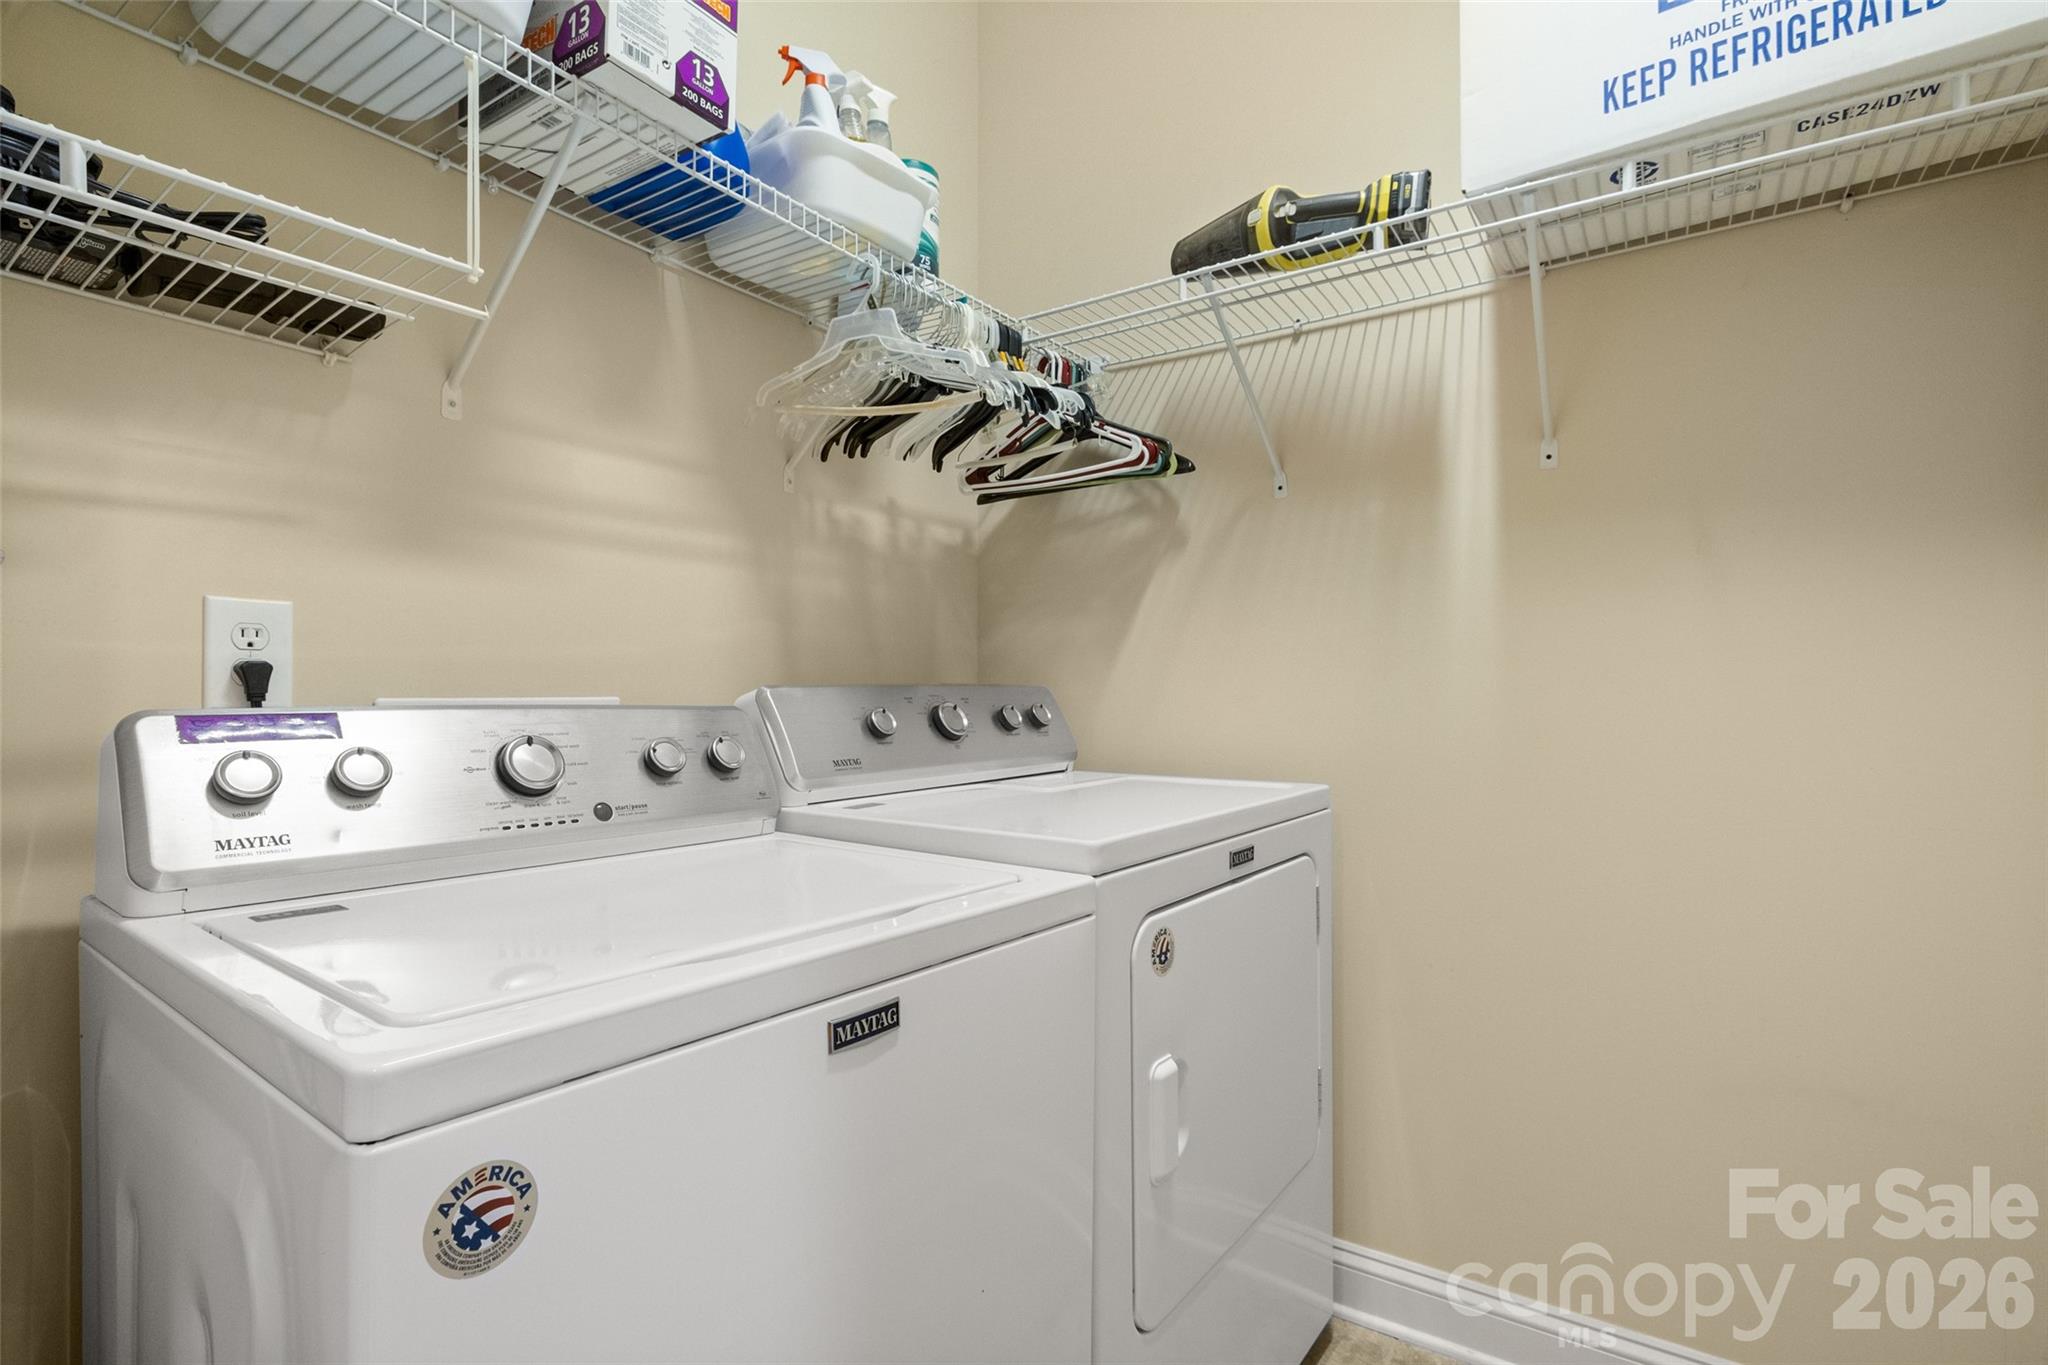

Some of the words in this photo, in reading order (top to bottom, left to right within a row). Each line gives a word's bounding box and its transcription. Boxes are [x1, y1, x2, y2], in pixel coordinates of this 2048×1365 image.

[568, 4, 591, 38] 13
[1669, 12, 1744, 50] HANDLE
[1749, 0, 1798, 21] WITH
[567, 31, 589, 48] GALLON
[574, 42, 599, 64] BAGS
[692, 58, 715, 87] 13
[1602, 58, 1677, 115] KEEP
[1689, 0, 1950, 87] REFRIGERAT
[691, 77, 714, 96] GALLON
[682, 86, 699, 104] 200
[699, 97, 724, 120] BAGS
[1796, 82, 1941, 133] CASE24DZW
[919, 254, 931, 266] 75
[832, 758, 862, 768] MAYTAG
[215, 833, 292, 852] MAYTAG
[836, 1007, 897, 1045] MAYTAG
[437, 1165, 532, 1219] AMERICA
